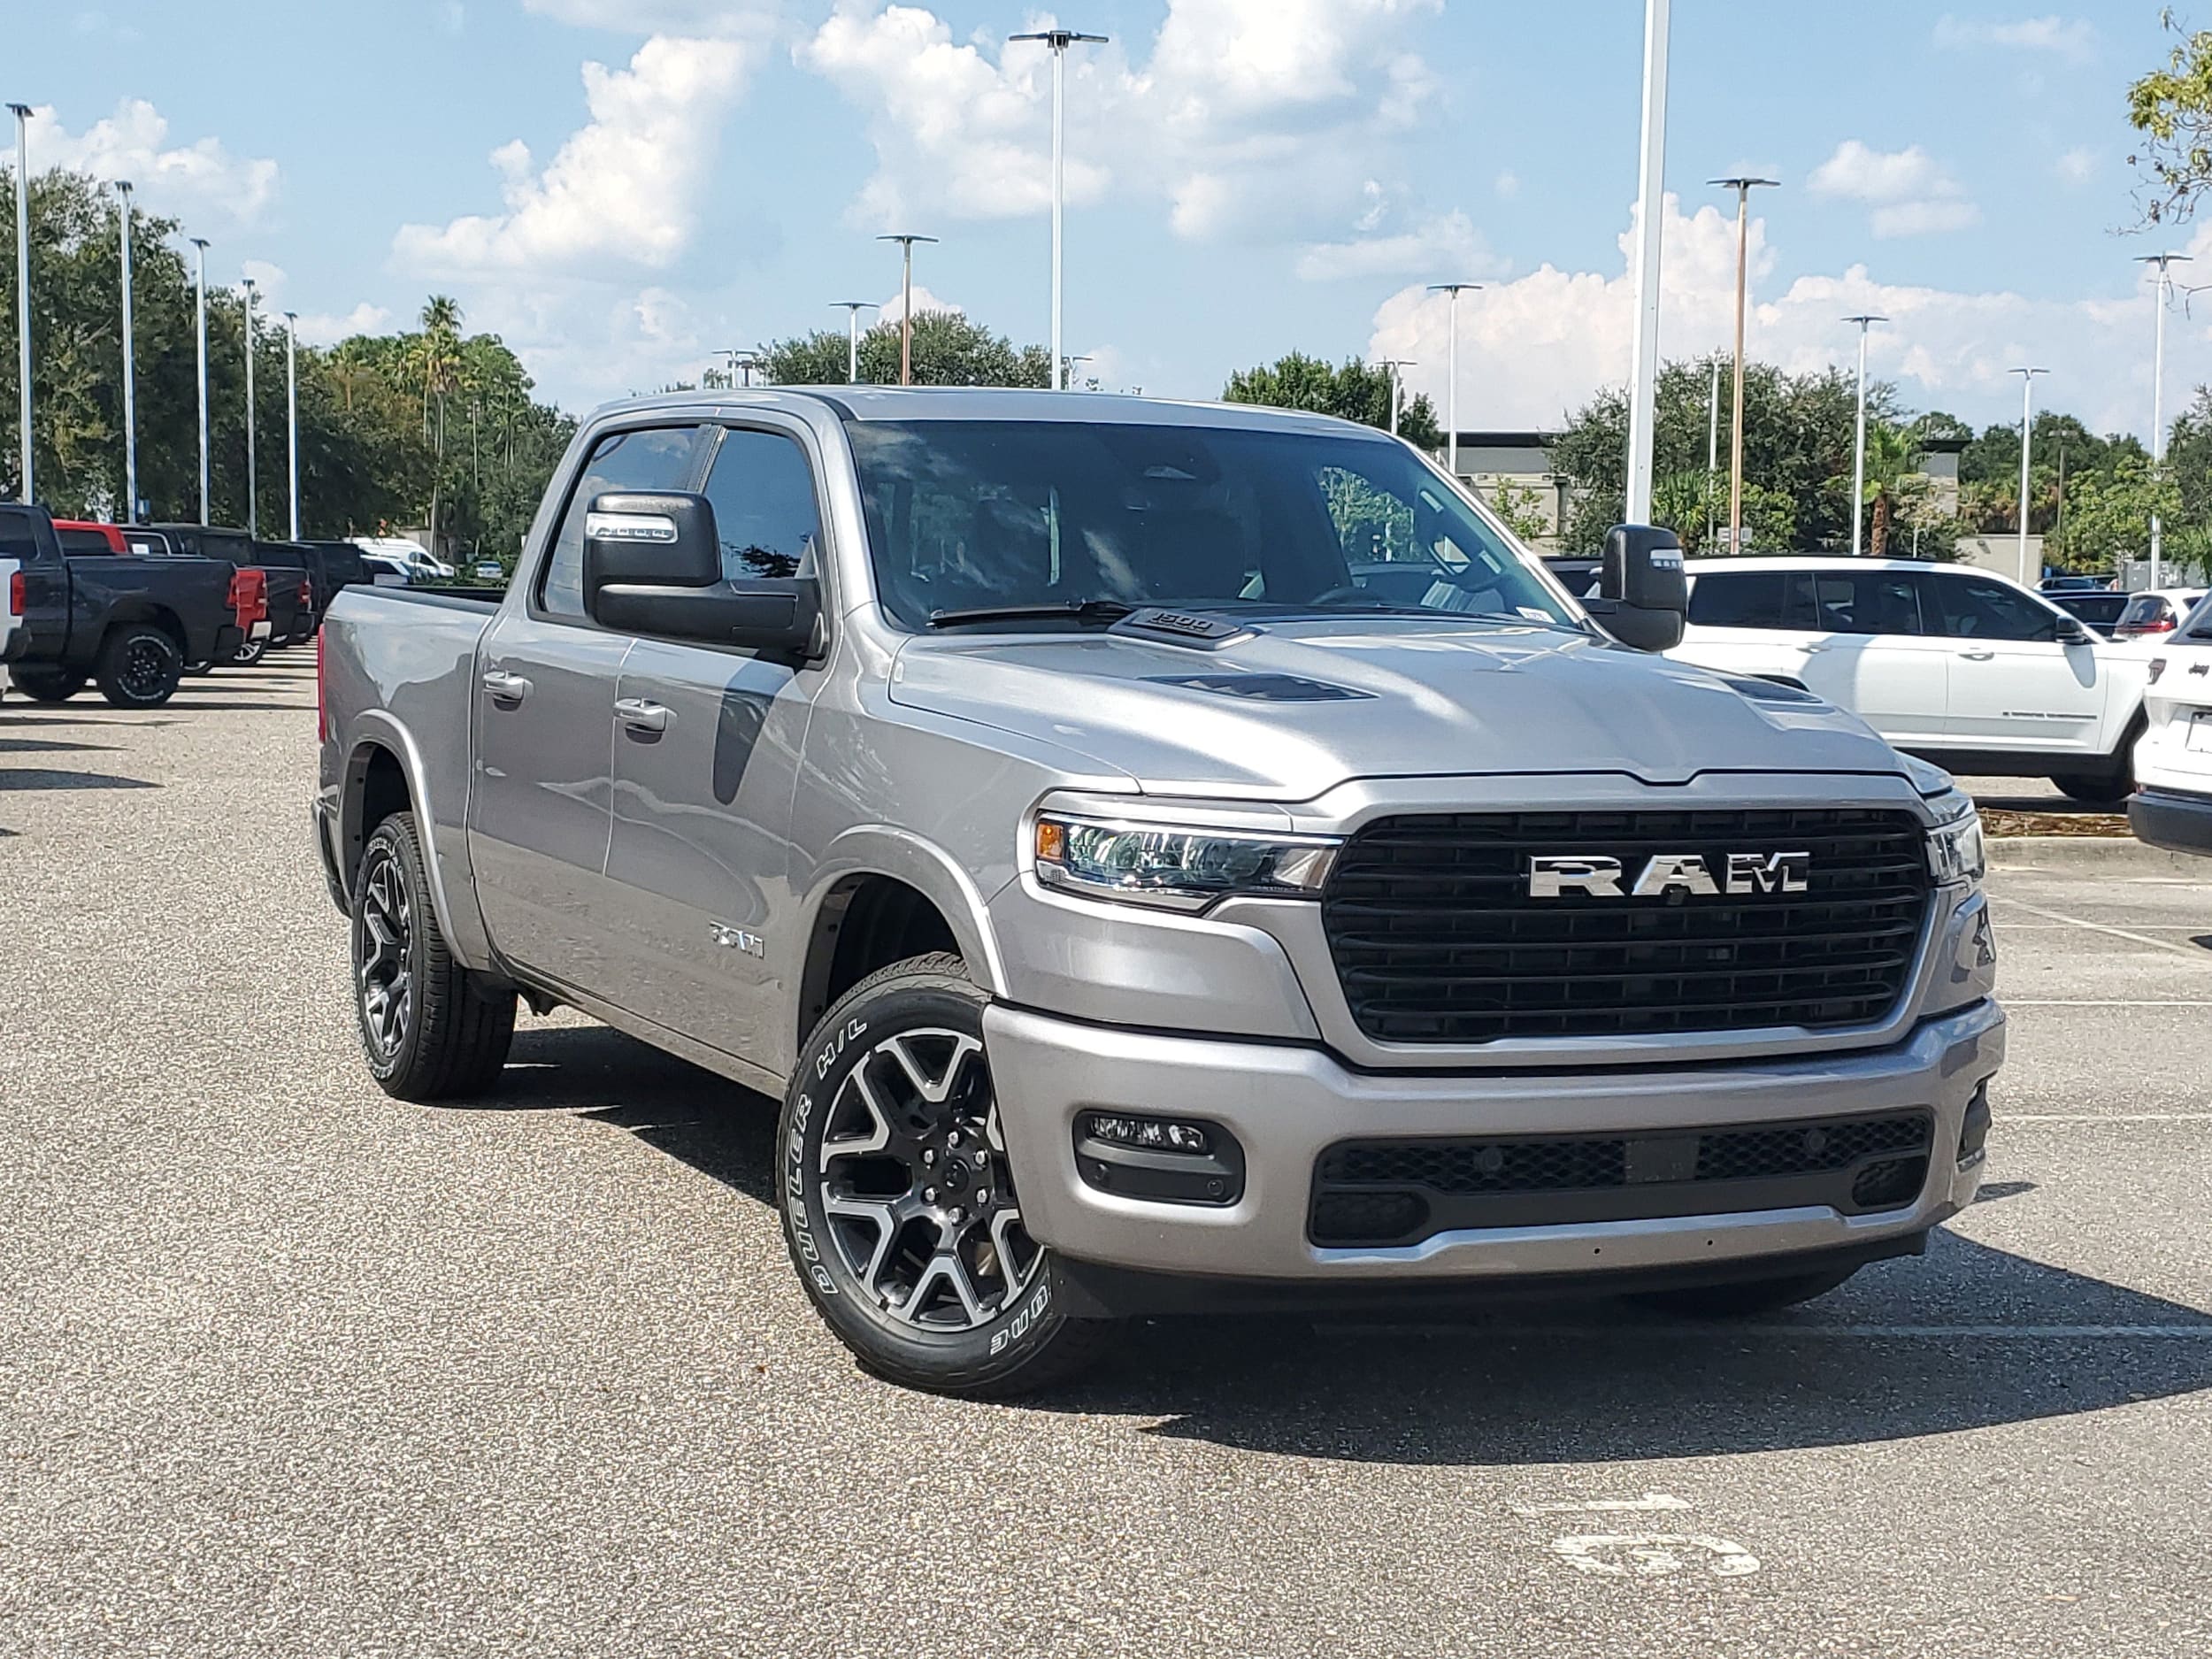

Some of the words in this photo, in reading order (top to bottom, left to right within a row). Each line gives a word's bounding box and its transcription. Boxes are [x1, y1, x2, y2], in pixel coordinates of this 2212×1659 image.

[1151, 612, 1213, 633] 1500
[1529, 851, 1811, 897] RAM
[787, 1093, 839, 1295] DUELER
[816, 1017, 868, 1081] H/L
